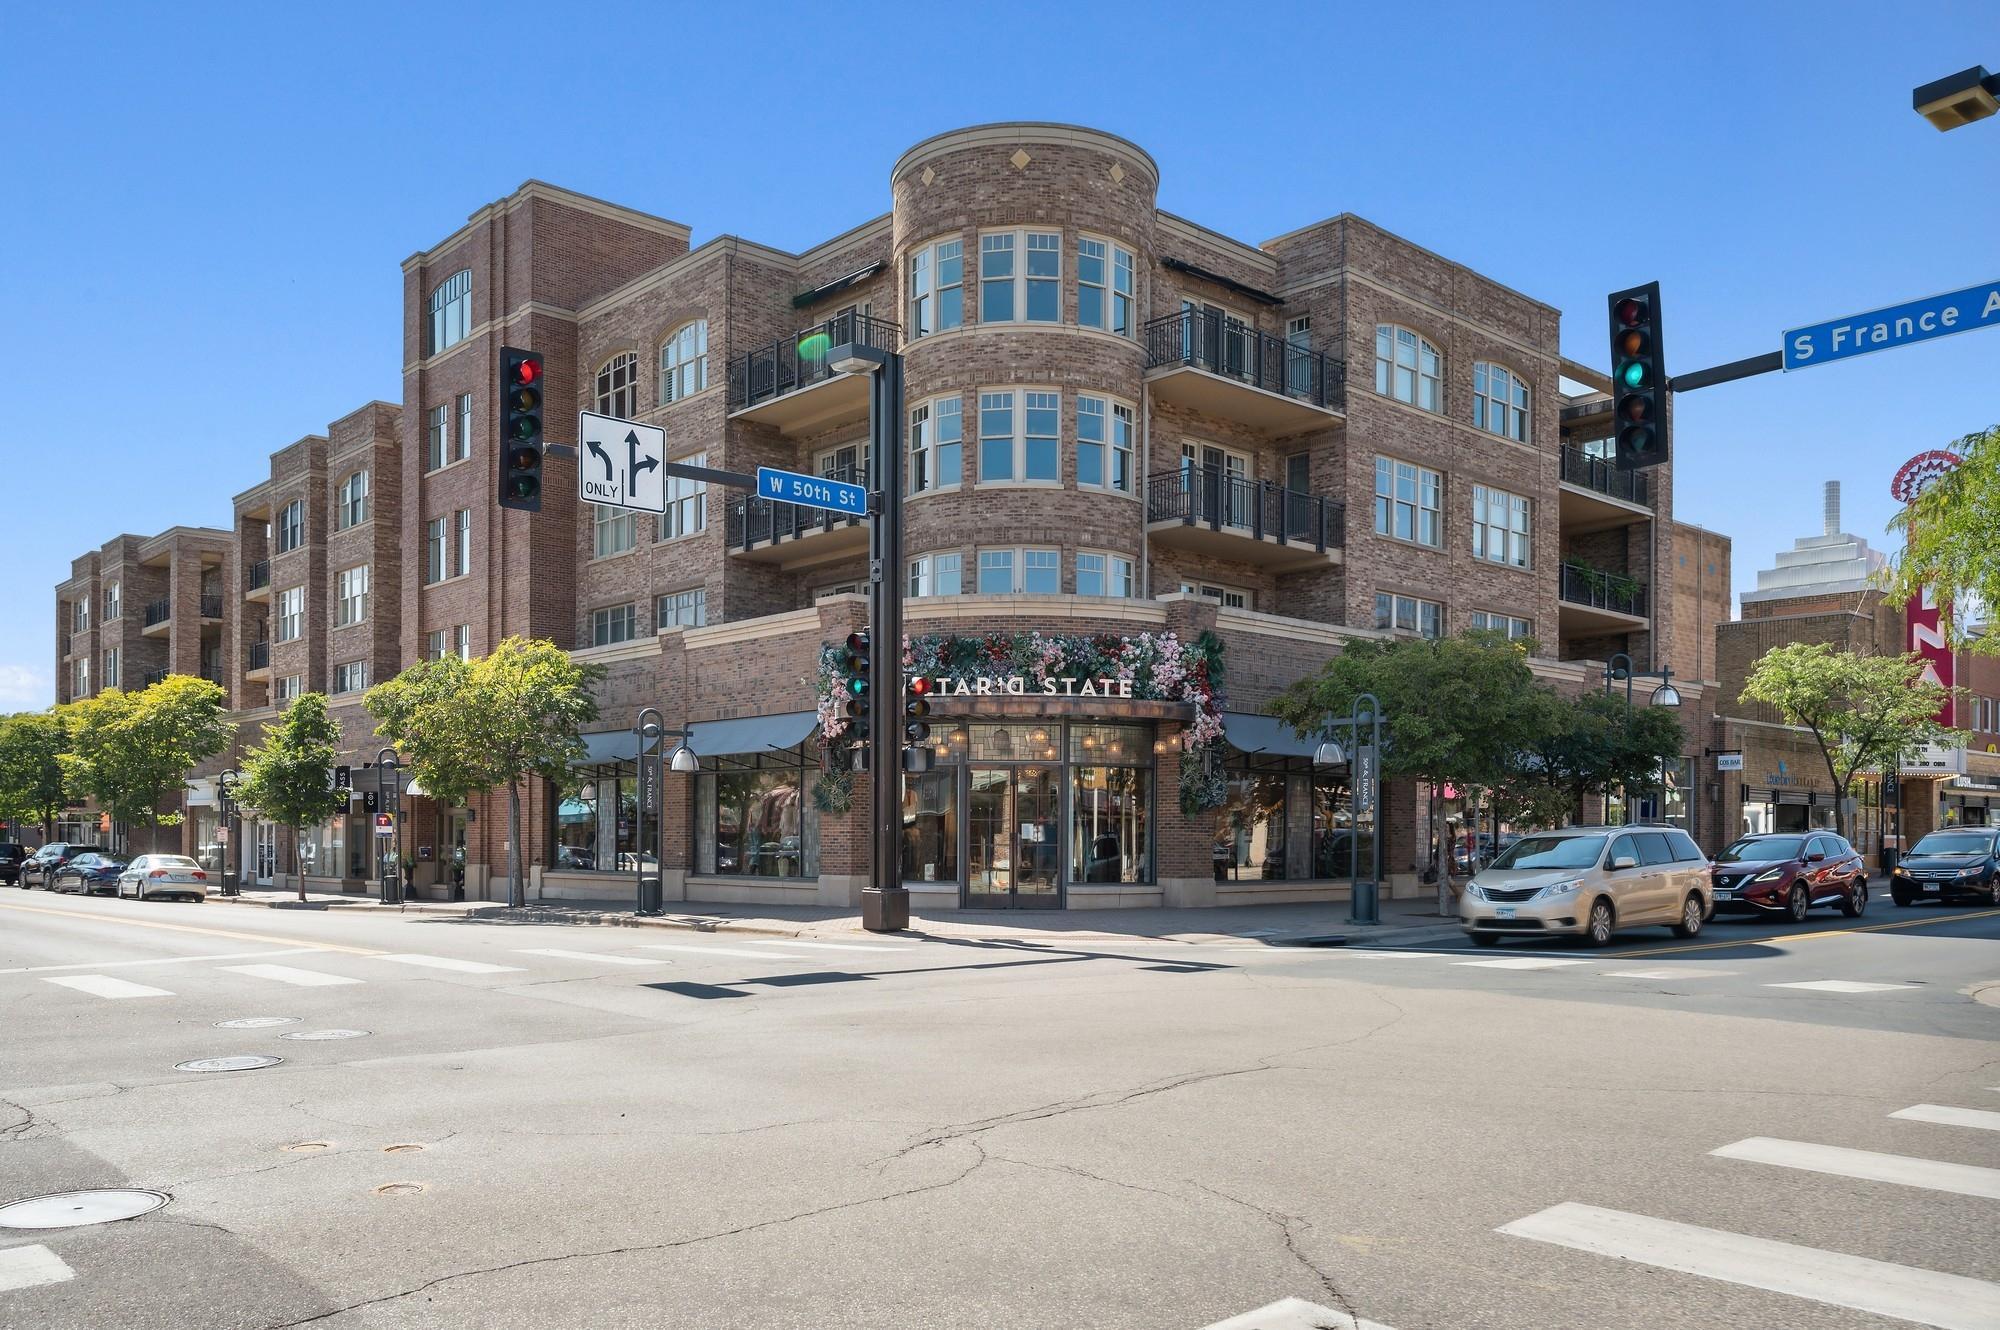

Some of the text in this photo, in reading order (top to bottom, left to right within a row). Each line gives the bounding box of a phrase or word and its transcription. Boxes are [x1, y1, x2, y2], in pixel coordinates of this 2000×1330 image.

[1794, 335, 1814, 360] S
[1832, 306, 1959, 352] France
[585, 481, 618, 498] ONLY
[770, 476, 856, 506] W 50th St
[1043, 677, 1132, 699] STATE
